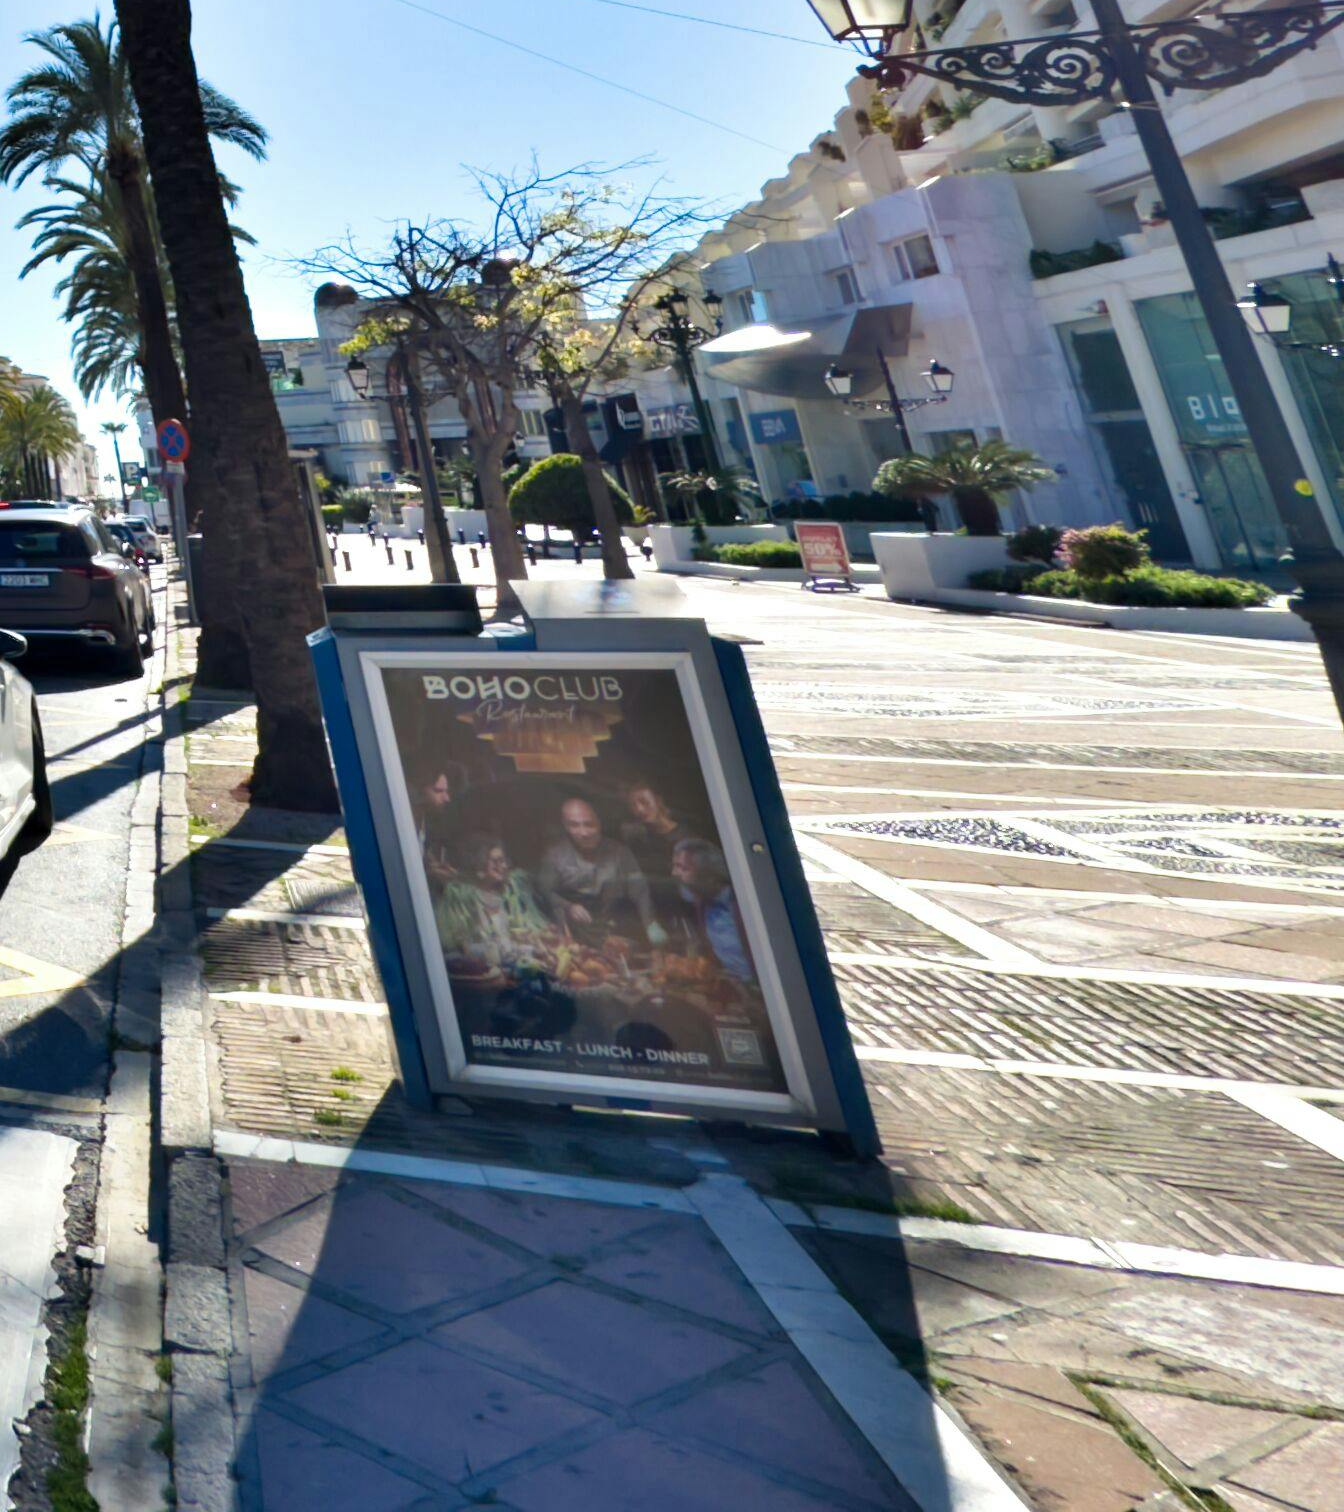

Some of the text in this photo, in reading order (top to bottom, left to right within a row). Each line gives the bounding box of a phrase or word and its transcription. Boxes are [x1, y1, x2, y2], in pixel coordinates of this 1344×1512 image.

[471, 1035, 562, 1053] BREAKFAST
[576, 1043, 632, 1059] LUNCH
[646, 1048, 709, 1065] DINNER
